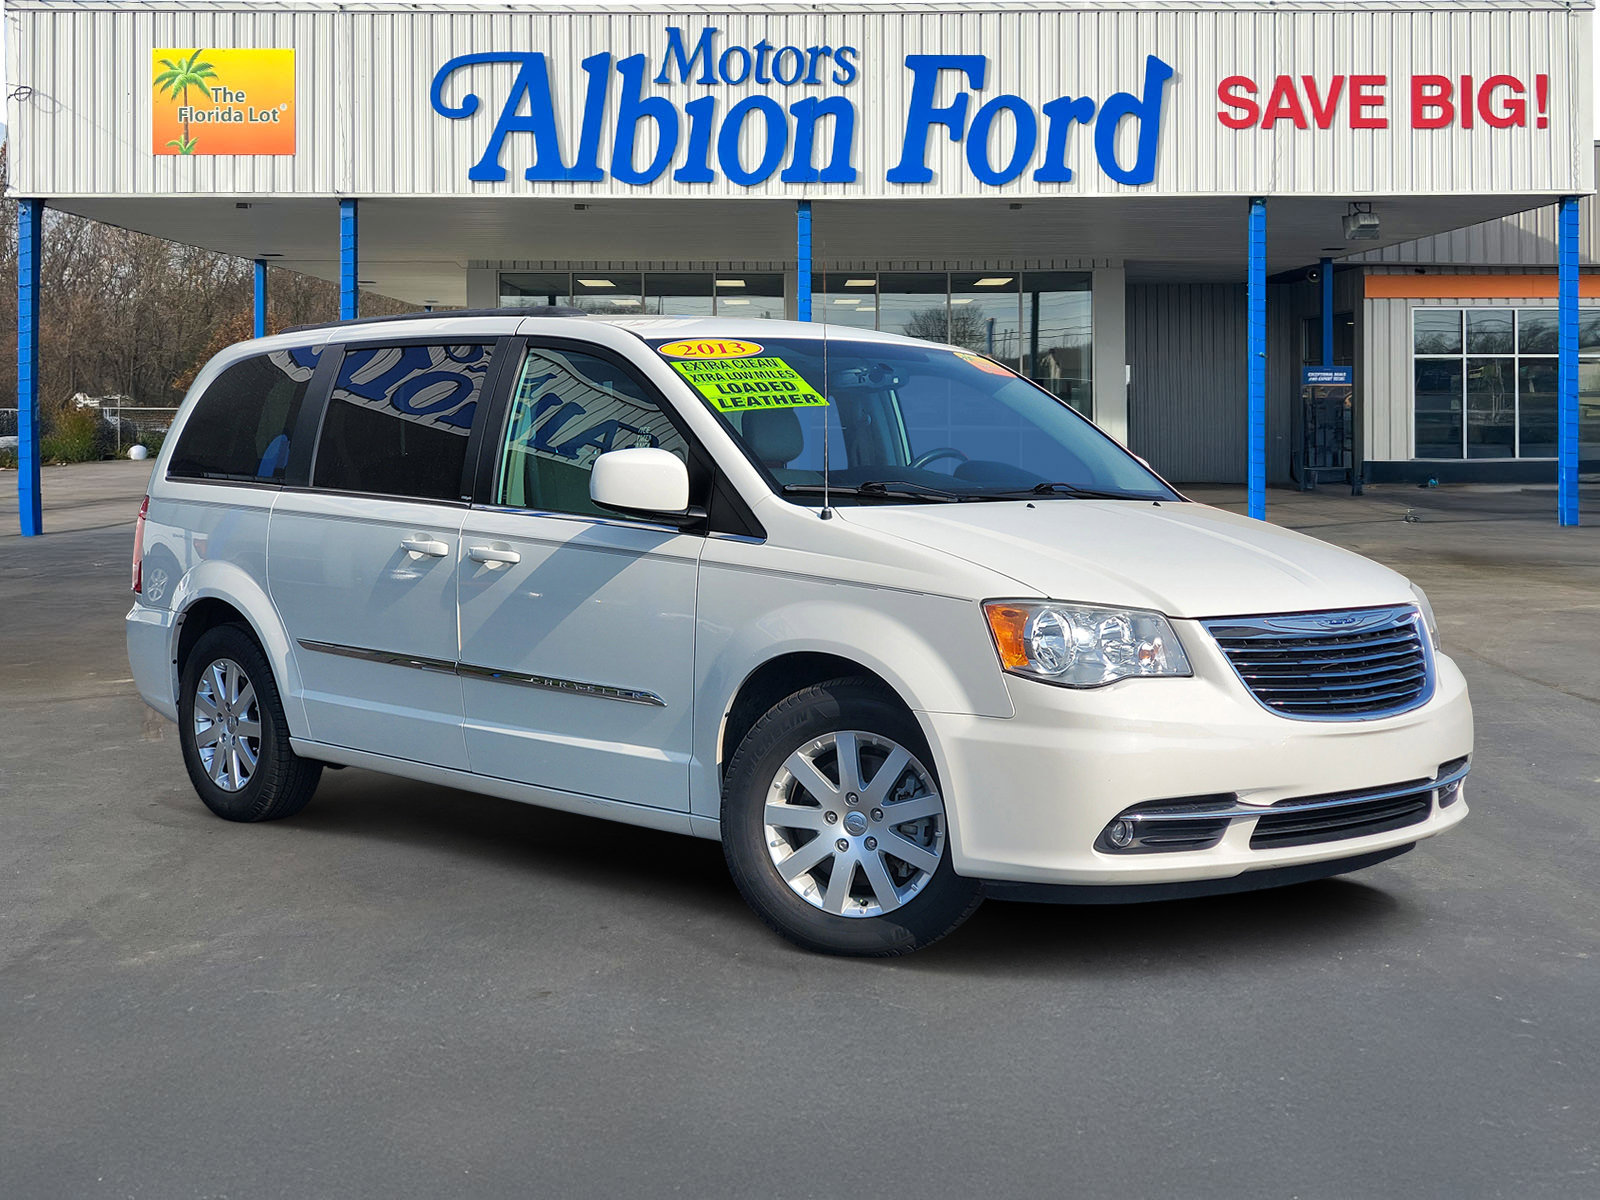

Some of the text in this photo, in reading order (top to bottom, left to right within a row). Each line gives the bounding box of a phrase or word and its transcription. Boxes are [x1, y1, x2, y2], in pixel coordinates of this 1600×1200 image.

[653, 27, 857, 86] Motors
[210, 86, 246, 103] The
[1217, 74, 1548, 130] SAVE BIG!
[178, 106, 244, 122] Florida
[430, 51, 1174, 186] Albion Ford
[677, 342, 746, 356] 2013
[681, 358, 778, 372] EXTRA CLEAN
[689, 369, 796, 383] XTRA LOW MILES
[715, 381, 797, 395] LOADED
[717, 393, 819, 409] LEATHER
[530, 677, 642, 700] CHRYSLER
